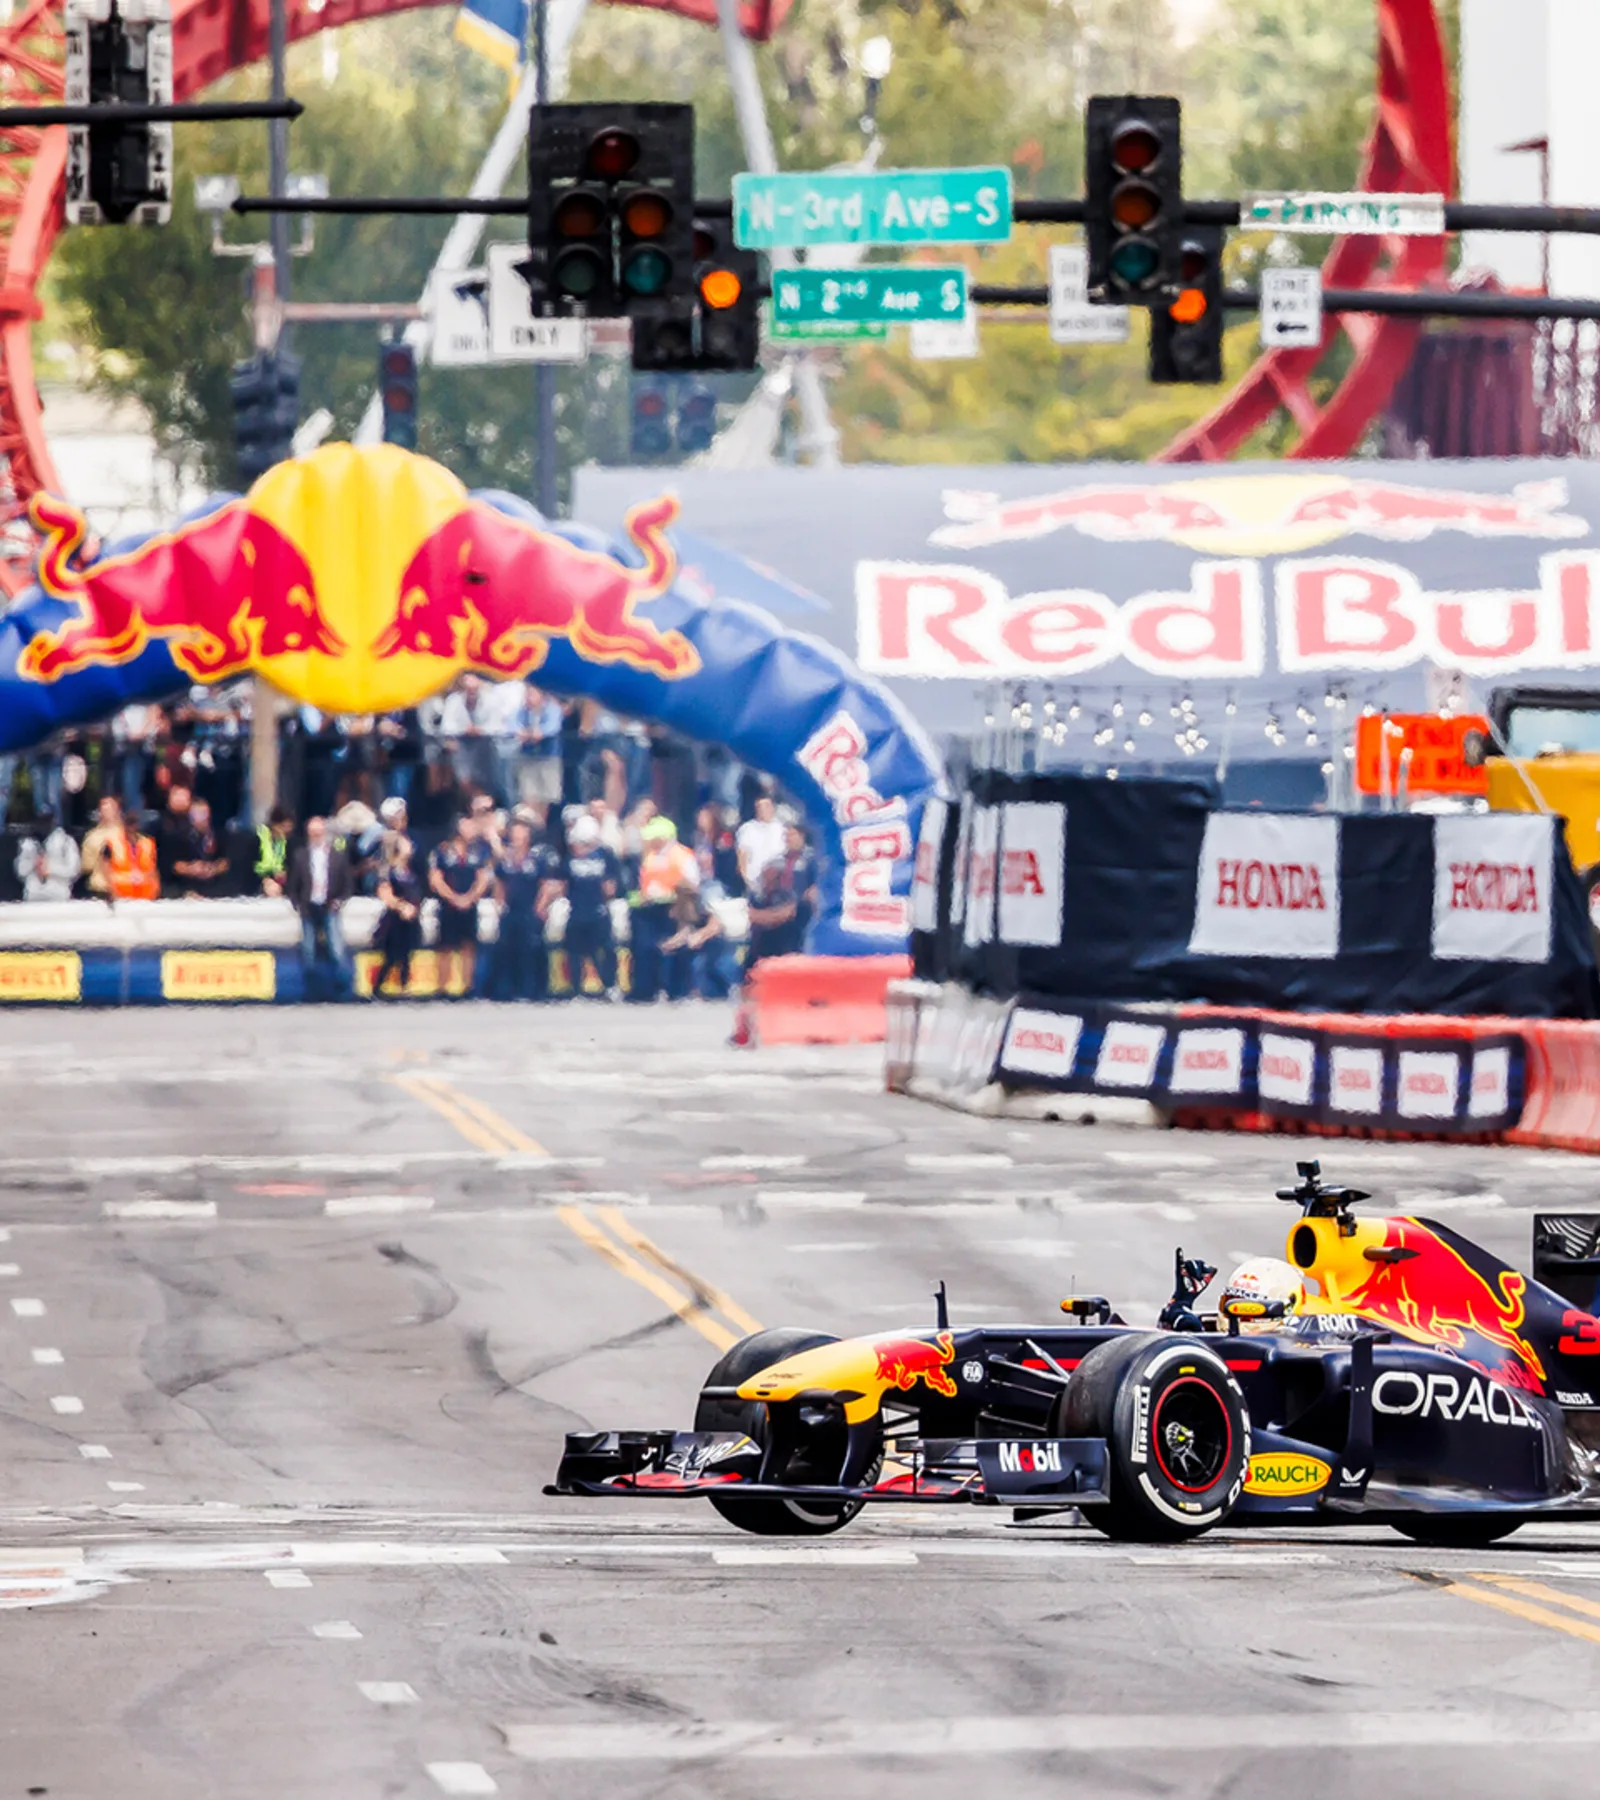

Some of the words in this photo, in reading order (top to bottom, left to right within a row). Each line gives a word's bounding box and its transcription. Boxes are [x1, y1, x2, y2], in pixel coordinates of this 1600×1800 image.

[939, 278, 961, 312] S
[874, 567, 1249, 668] Red
[803, 716, 903, 824] Red
[845, 826, 907, 929] Bull
[1216, 858, 1326, 910] HONDA
[1447, 861, 1540, 913] HONDA
[1131, 1384, 1151, 1464] PIRELLI
[999, 1442, 1062, 1473] Mobil
[1254, 1465, 1318, 1483] RAUCH
